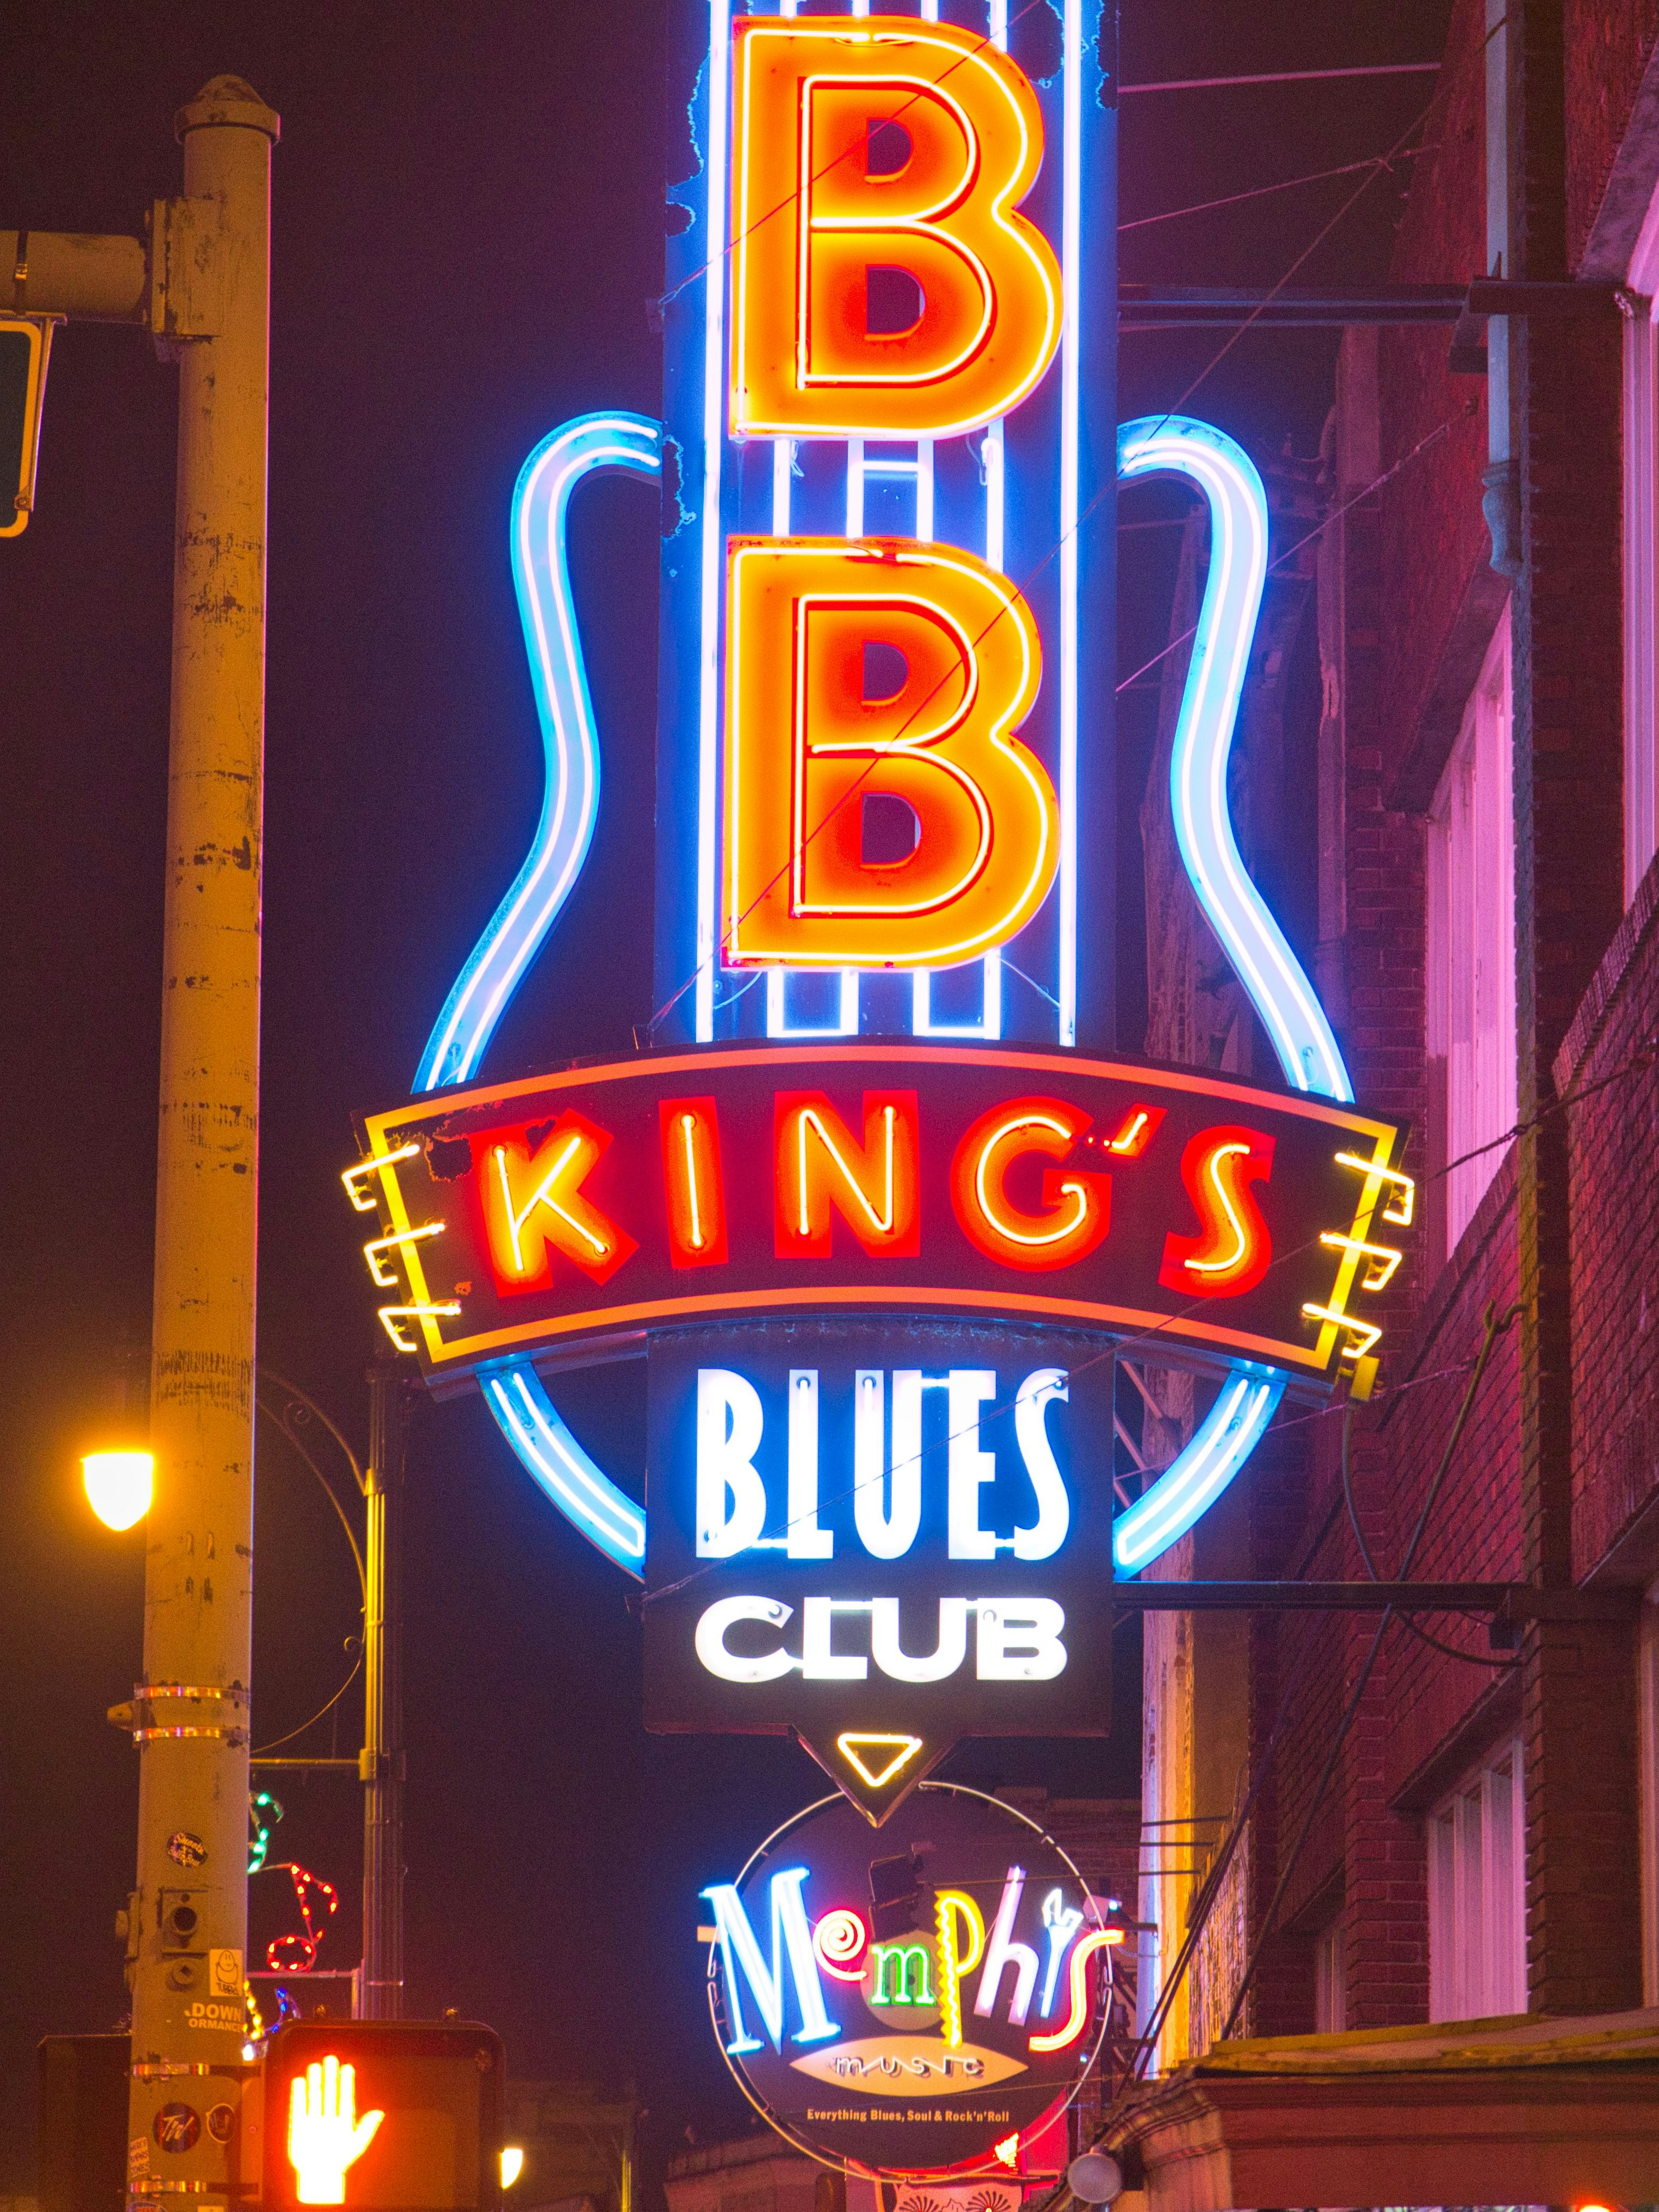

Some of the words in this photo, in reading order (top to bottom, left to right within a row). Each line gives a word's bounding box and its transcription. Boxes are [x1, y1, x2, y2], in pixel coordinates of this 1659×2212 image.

[729, 15, 1063, 440] B
[721, 534, 1061, 971] B
[469, 1088, 1276, 1298] KING'S
[696, 1368, 1069, 1560] BLUES
[695, 1595, 1067, 1682] CLUB
[184, 2002, 241, 2022] DOWN
[699, 1866, 1125, 2056] Memphis
[807, 2109, 867, 2122] Everything
[870, 2109, 904, 2122] Blues,
[907, 2110, 932, 2121] Soul
[934, 2111, 942, 2121] &
[945, 2110, 1009, 2122] Rock'n'Roll
